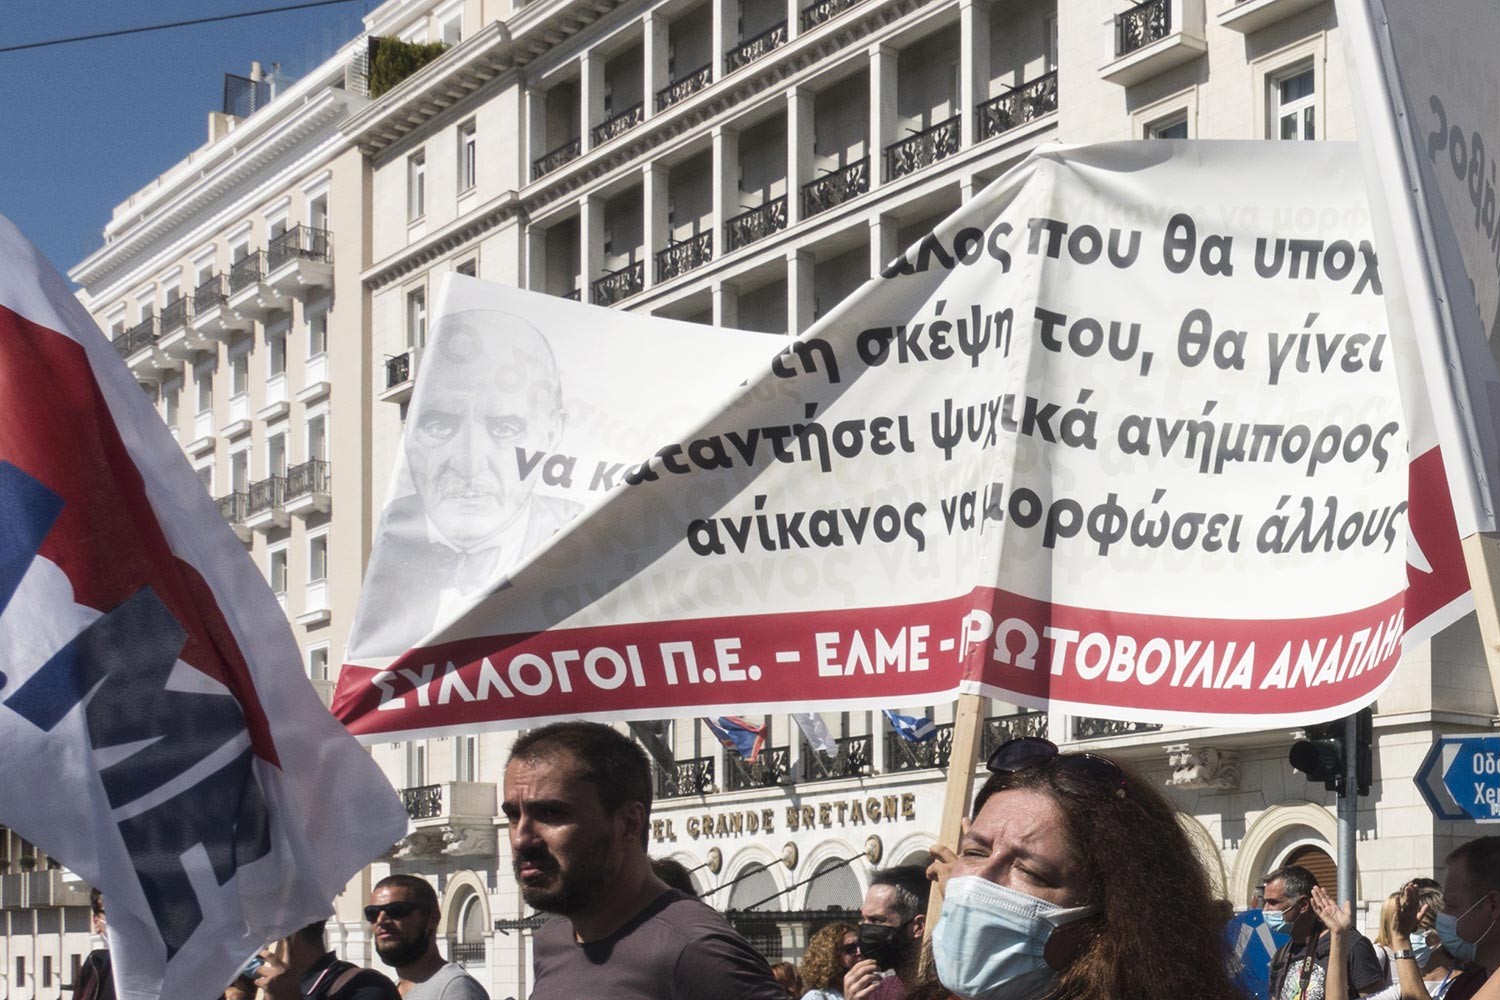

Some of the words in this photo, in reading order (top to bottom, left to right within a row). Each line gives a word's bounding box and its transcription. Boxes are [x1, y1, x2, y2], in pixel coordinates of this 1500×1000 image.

[1027, 217, 1142, 269] που
[1164, 213, 1234, 277] θα
[856, 299, 1015, 368] σκέψη
[1034, 306, 1155, 377] του,
[1177, 308, 1246, 372] θα
[1267, 312, 1387, 386] γίνει
[515, 447, 577, 489] να
[588, 402, 916, 492] καταντήσει
[931, 389, 1098, 460] ψυχικά
[1118, 400, 1400, 478] ανήμπορος
[686, 494, 927, 558] ανίκανος
[941, 500, 975, 531] να
[980, 482, 1243, 557] μορφώσει
[1256, 489, 1409, 556] άλλους
[371, 644, 647, 711] ΣΥΛΛΟΓΟΙ
[663, 635, 763, 684] Π.Ε.
[814, 624, 930, 678] ΕΛΜΕ
[959, 608, 1256, 691] ΠΡΩΤΟΒΟΥΛΙΑ
[650, 818, 678, 843] EL
[686, 807, 775, 840] GRANDE
[785, 791, 917, 831] BRETAGNE
